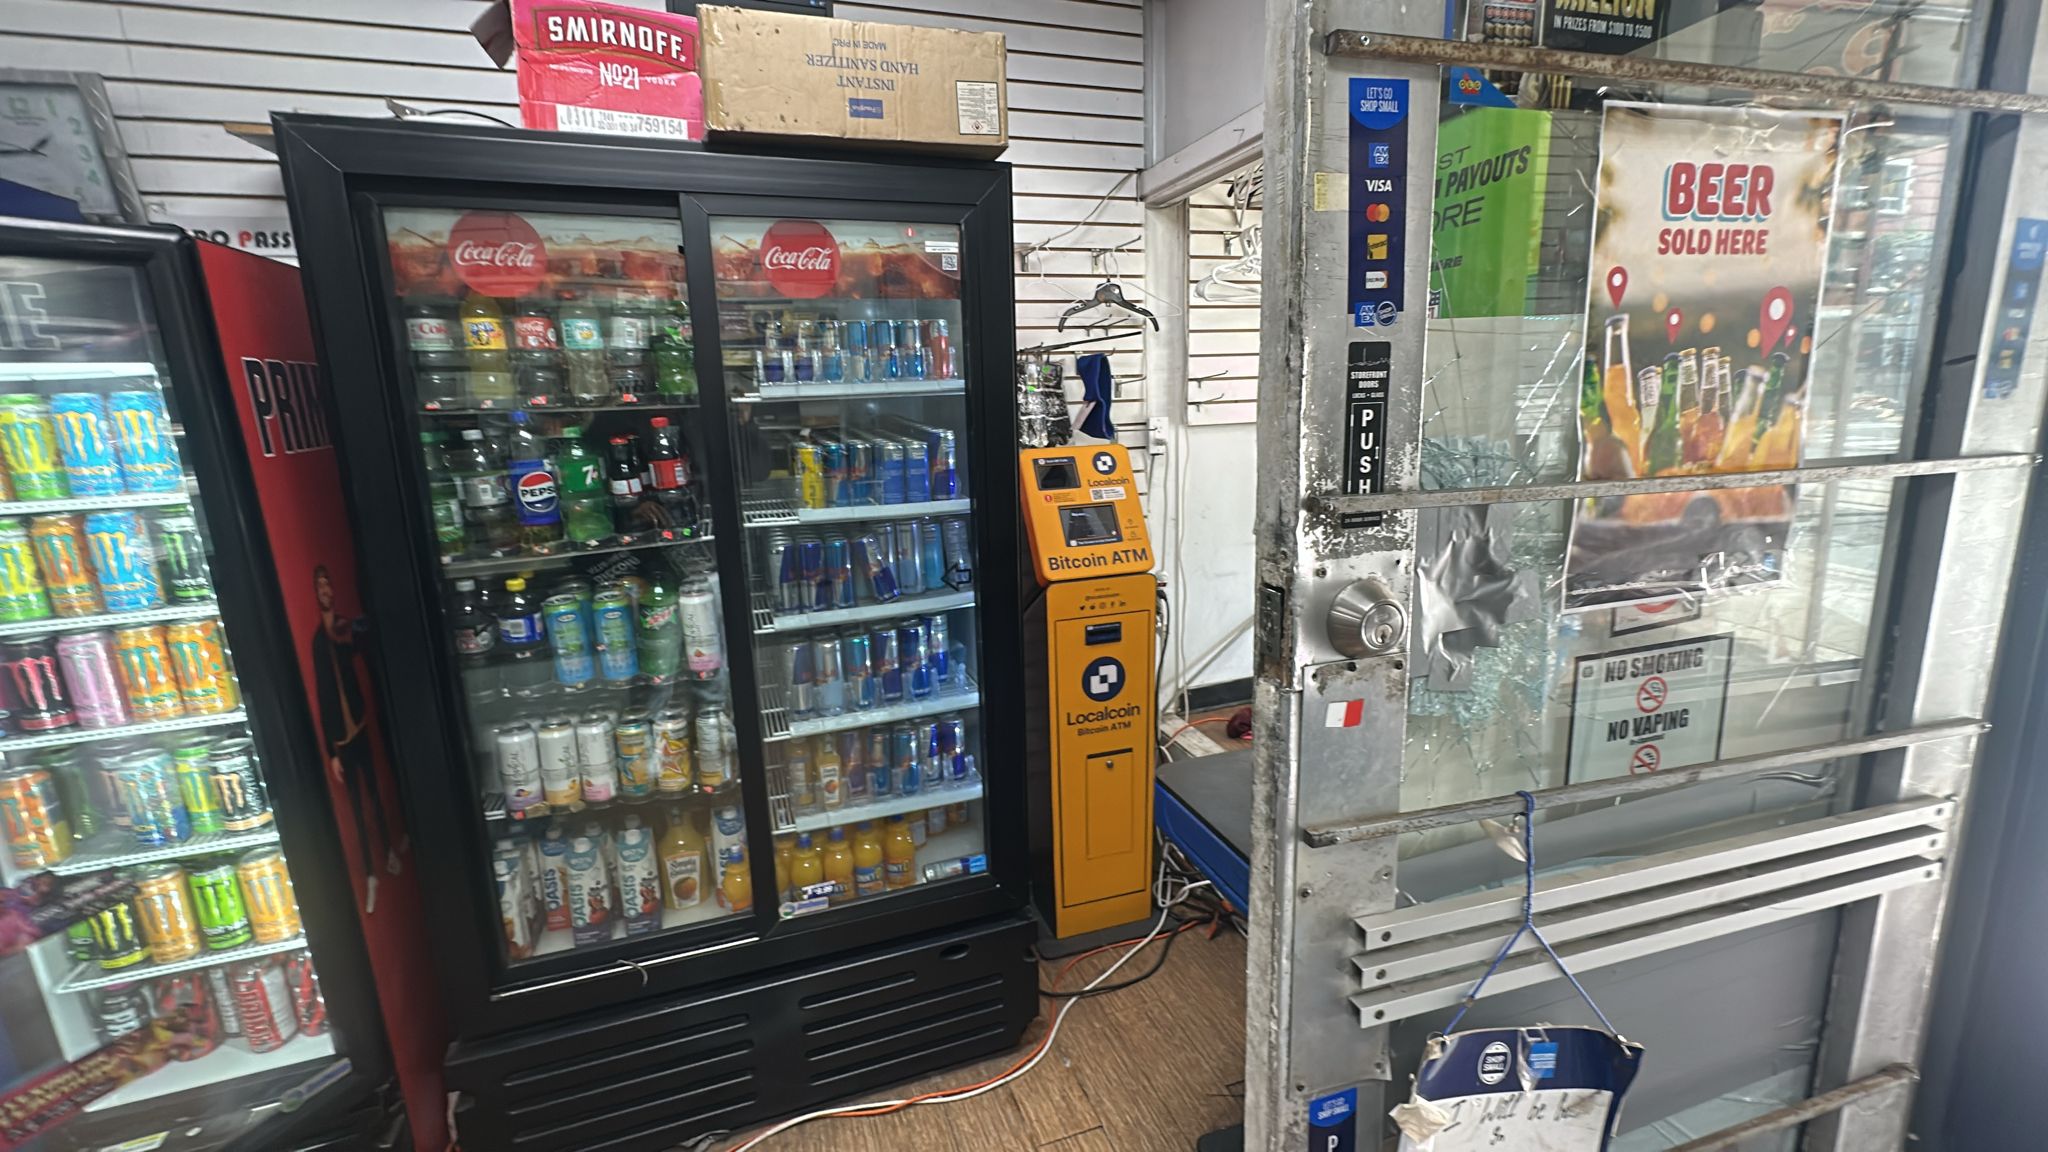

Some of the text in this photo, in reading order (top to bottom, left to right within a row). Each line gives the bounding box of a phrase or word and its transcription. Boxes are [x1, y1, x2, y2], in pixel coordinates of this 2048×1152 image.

[1553, 14, 1562, 28] IN
[1563, 15, 1588, 32] PRIZES
[1588, 18, 1608, 34] FROM
[1625, 23, 1634, 37] TO
[547, 15, 684, 60] SMIRNOFF
[832, 38, 887, 50] MADE IN PRC
[805, 54, 919, 75] HAND SANITIZER
[646, 76, 676, 87] VODKA
[836, 75, 895, 91] INSTANT
[1366, 87, 1393, 100] LET'S GO
[1360, 100, 1399, 113] SHOP SMALL
[1445, 144, 1532, 197] PAYOUTS
[1365, 179, 1393, 192] VISA
[1665, 161, 1775, 221] BEER
[1657, 227, 1770, 256] SOLD HERE
[455, 240, 537, 268] Coca-Cola
[764, 246, 833, 270] Coca-Cola
[1359, 409, 1374, 494] PUSH
[1087, 477, 1130, 488] Localcoin
[1048, 548, 1149, 571] Bitcoin ATM
[1604, 647, 1704, 682] NO SMOKING
[1066, 703, 1141, 726] Localcoin
[1606, 719, 1630, 742] NO
[1632, 708, 1690, 737] VAPING
[1077, 721, 1132, 736] Bitcoin ATM
[543, 868, 560, 912] OASIS
[621, 874, 641, 919] OASIS
[569, 884, 588, 928] OASIS
